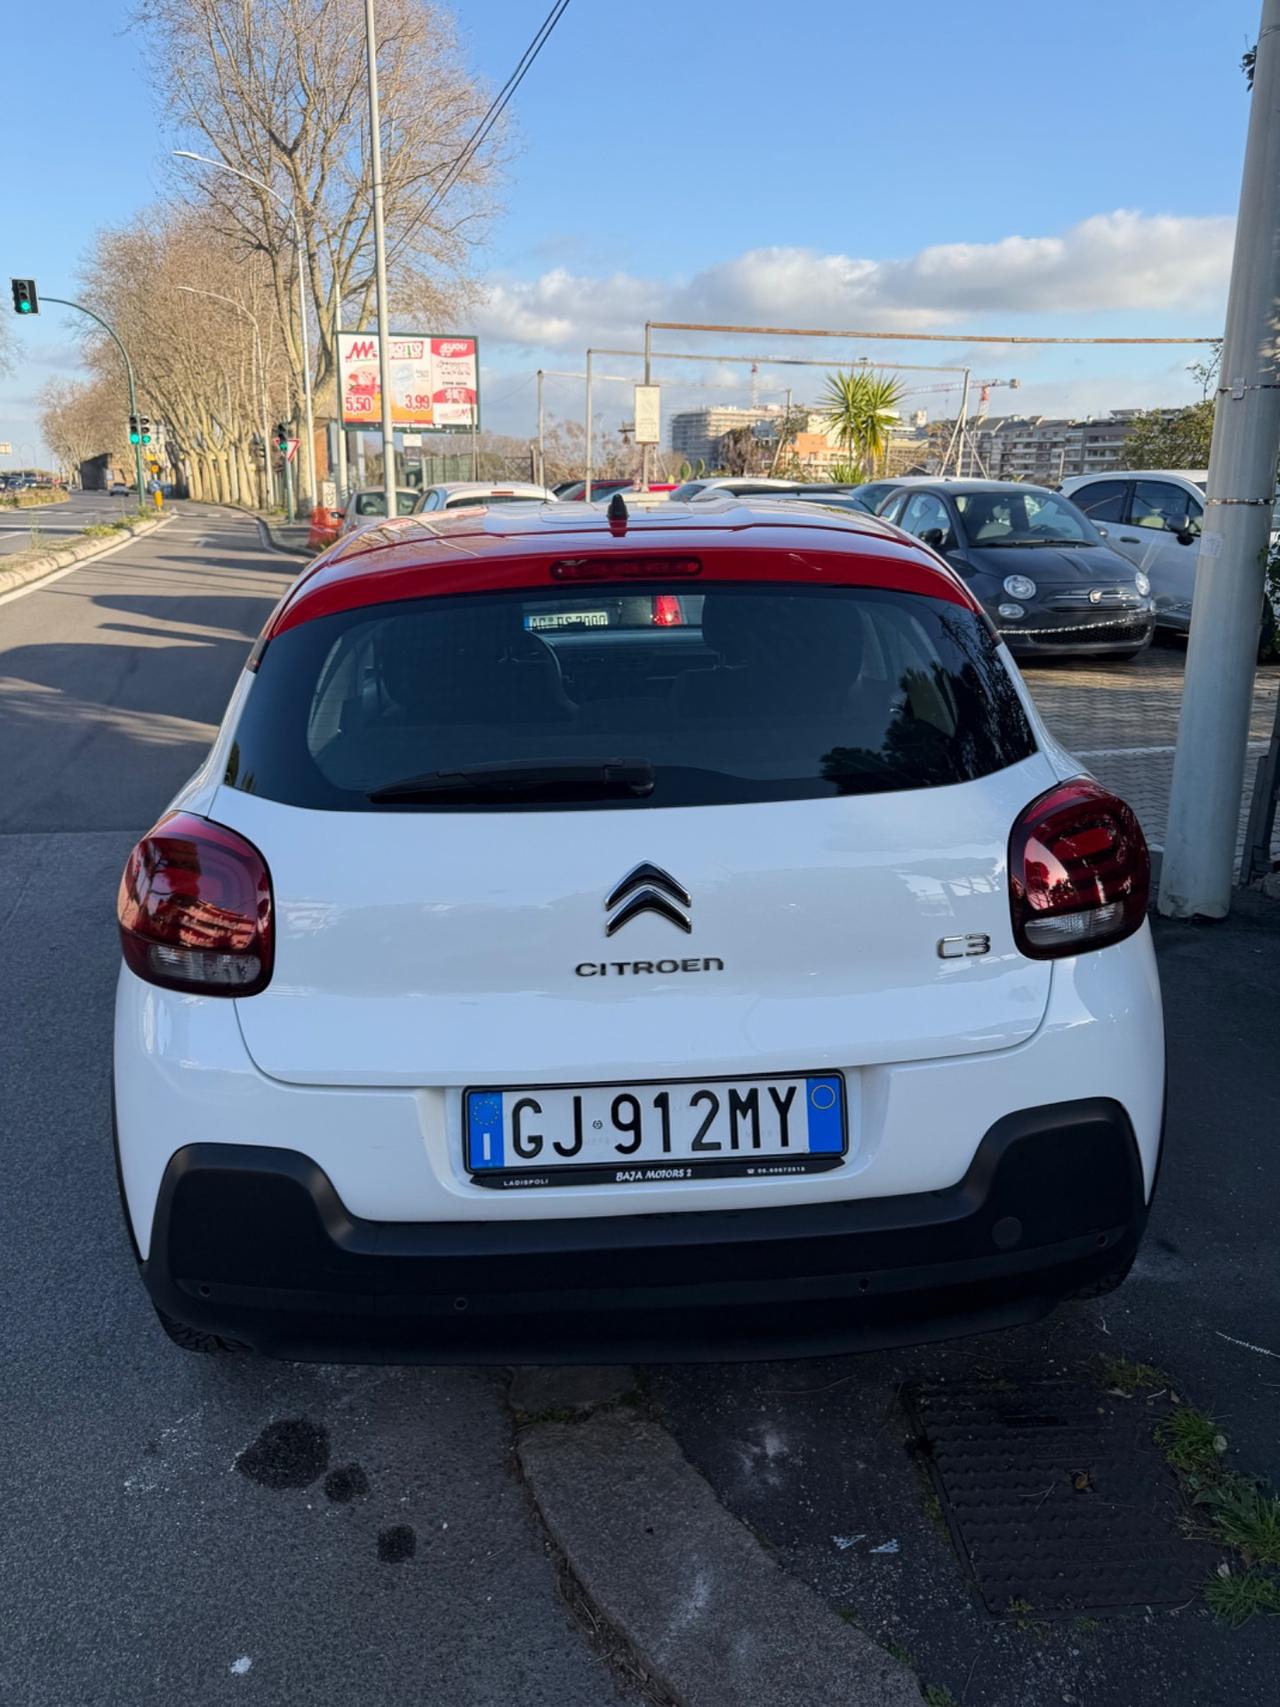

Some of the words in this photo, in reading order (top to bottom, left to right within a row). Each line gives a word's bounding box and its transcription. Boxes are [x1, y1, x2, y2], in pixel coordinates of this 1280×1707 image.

[345, 396, 371, 412] 5,50
[405, 395, 430, 410] 3,99
[936, 932, 992, 960] C3
[503, 1178, 549, 1187] LADISPOLI
[615, 1171, 643, 1182] BAJA
[645, 1169, 684, 1180] MOTORS
[685, 1168, 692, 1178] 2
